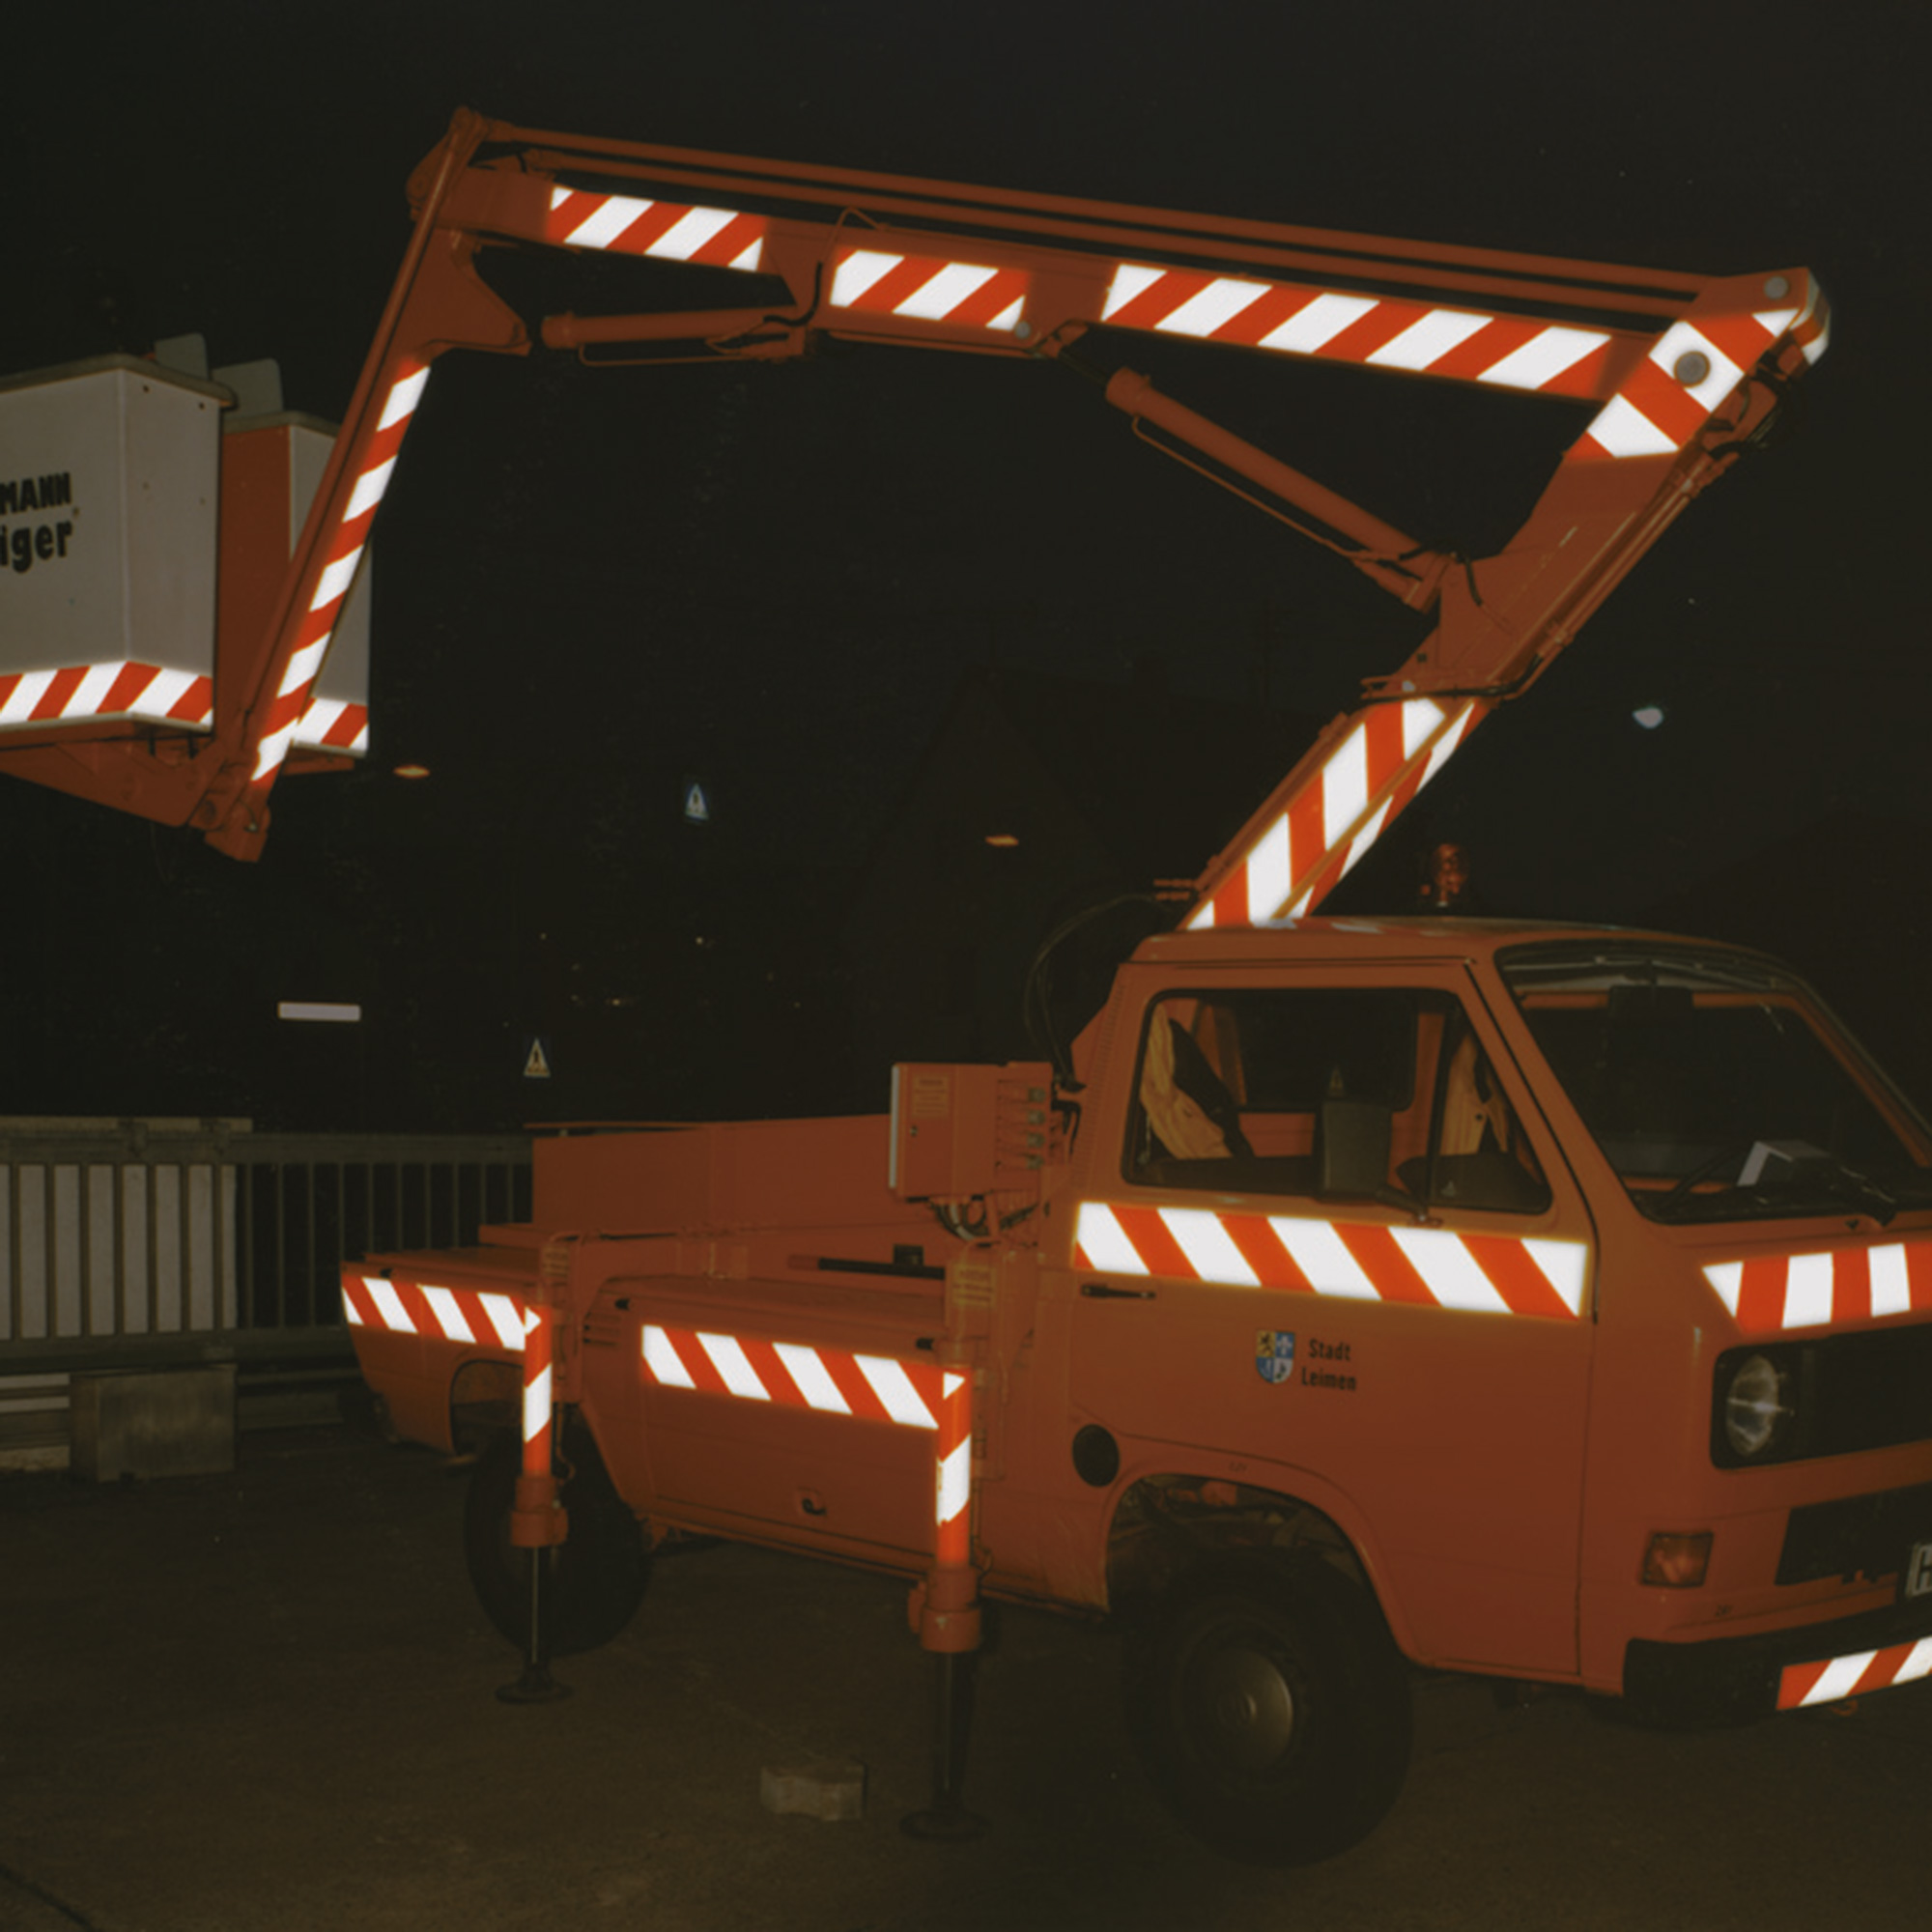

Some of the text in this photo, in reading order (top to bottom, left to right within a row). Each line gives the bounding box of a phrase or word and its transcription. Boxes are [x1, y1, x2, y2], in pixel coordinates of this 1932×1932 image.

[0, 520, 73, 574] iger
[1309, 1338, 1350, 1361] Stadt
[1301, 1366, 1356, 1391] Leimen
